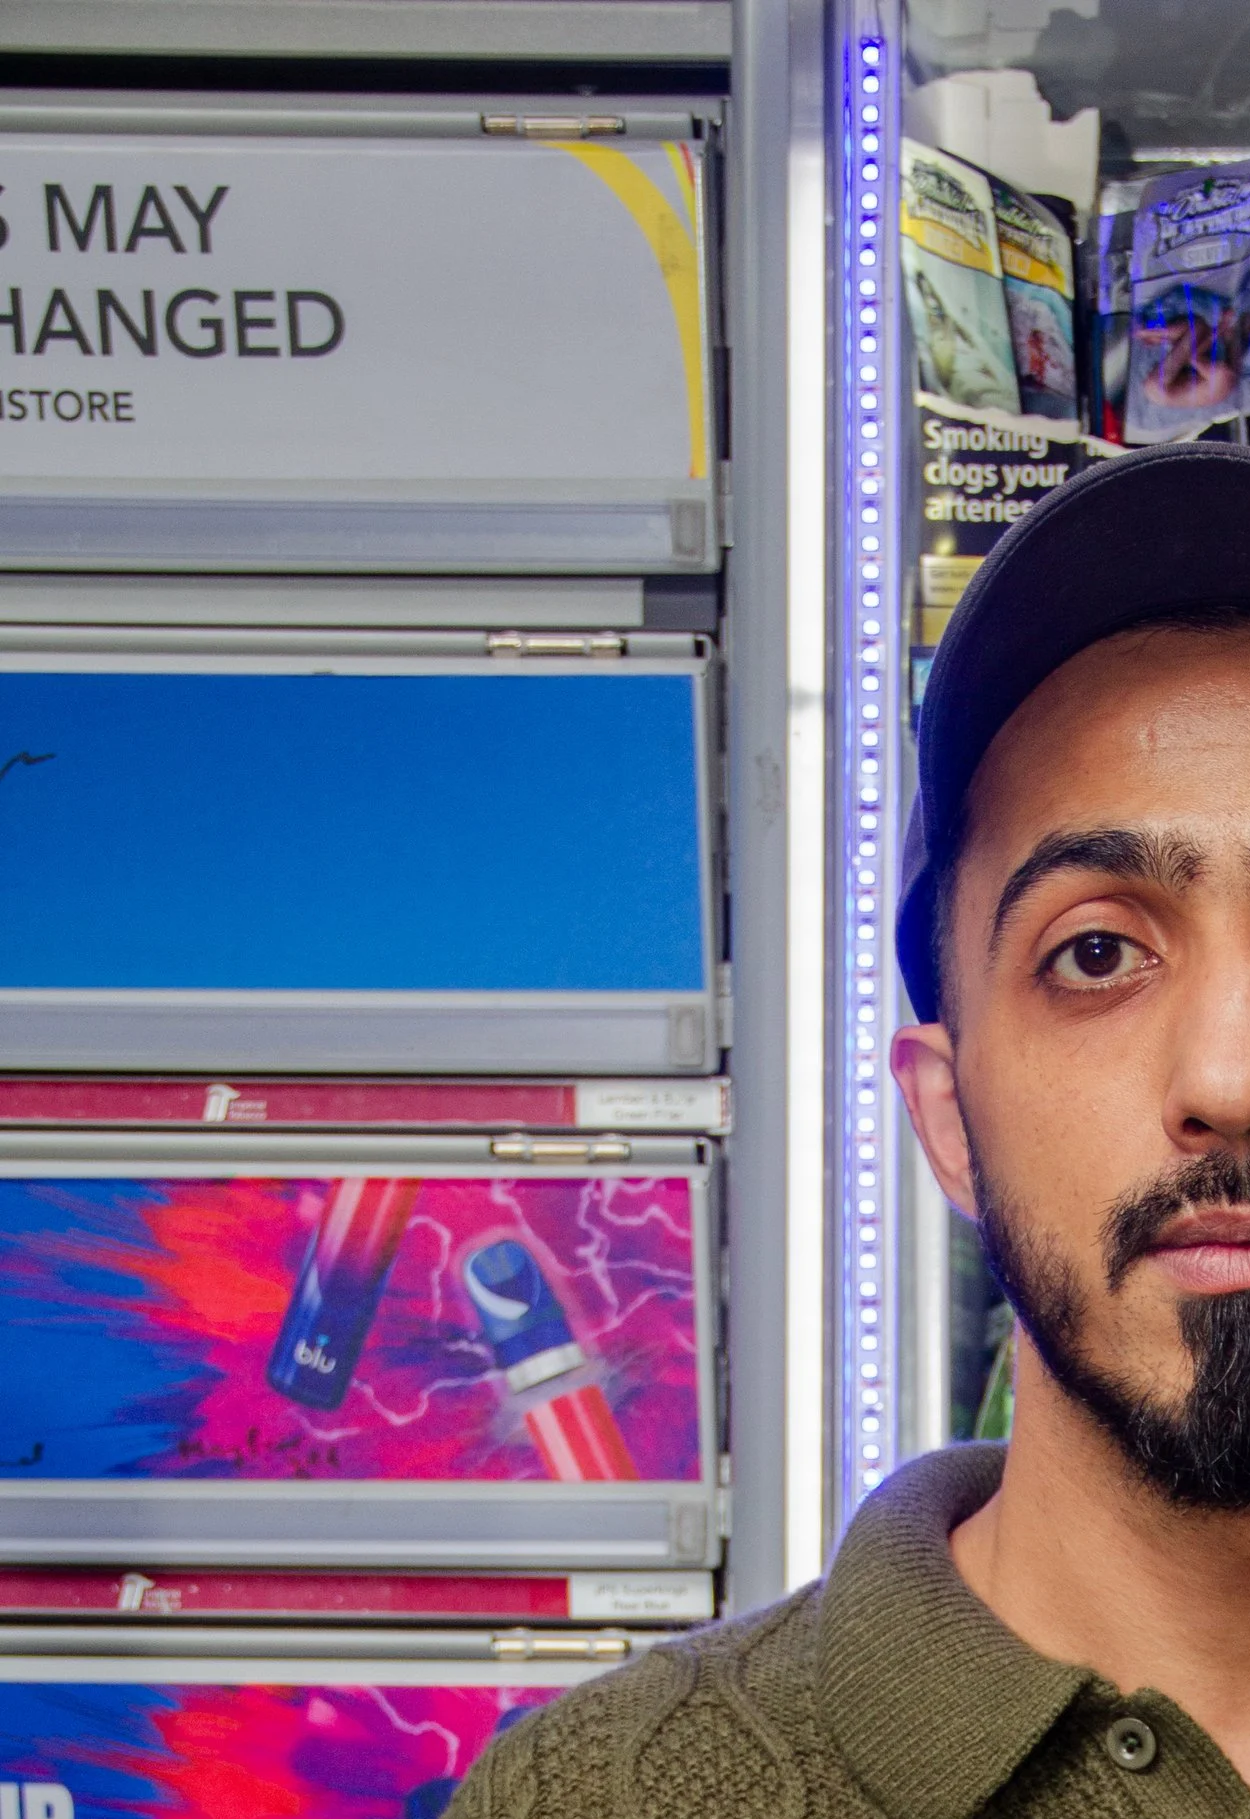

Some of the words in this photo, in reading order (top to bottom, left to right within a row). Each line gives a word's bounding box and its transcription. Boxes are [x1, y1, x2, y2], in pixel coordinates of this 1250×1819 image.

[43, 184, 230, 254] MAY
[924, 418, 1048, 459] Smoking
[924, 459, 998, 494] clogs
[1003, 463, 1069, 494] your
[294, 1334, 337, 1374] blu
